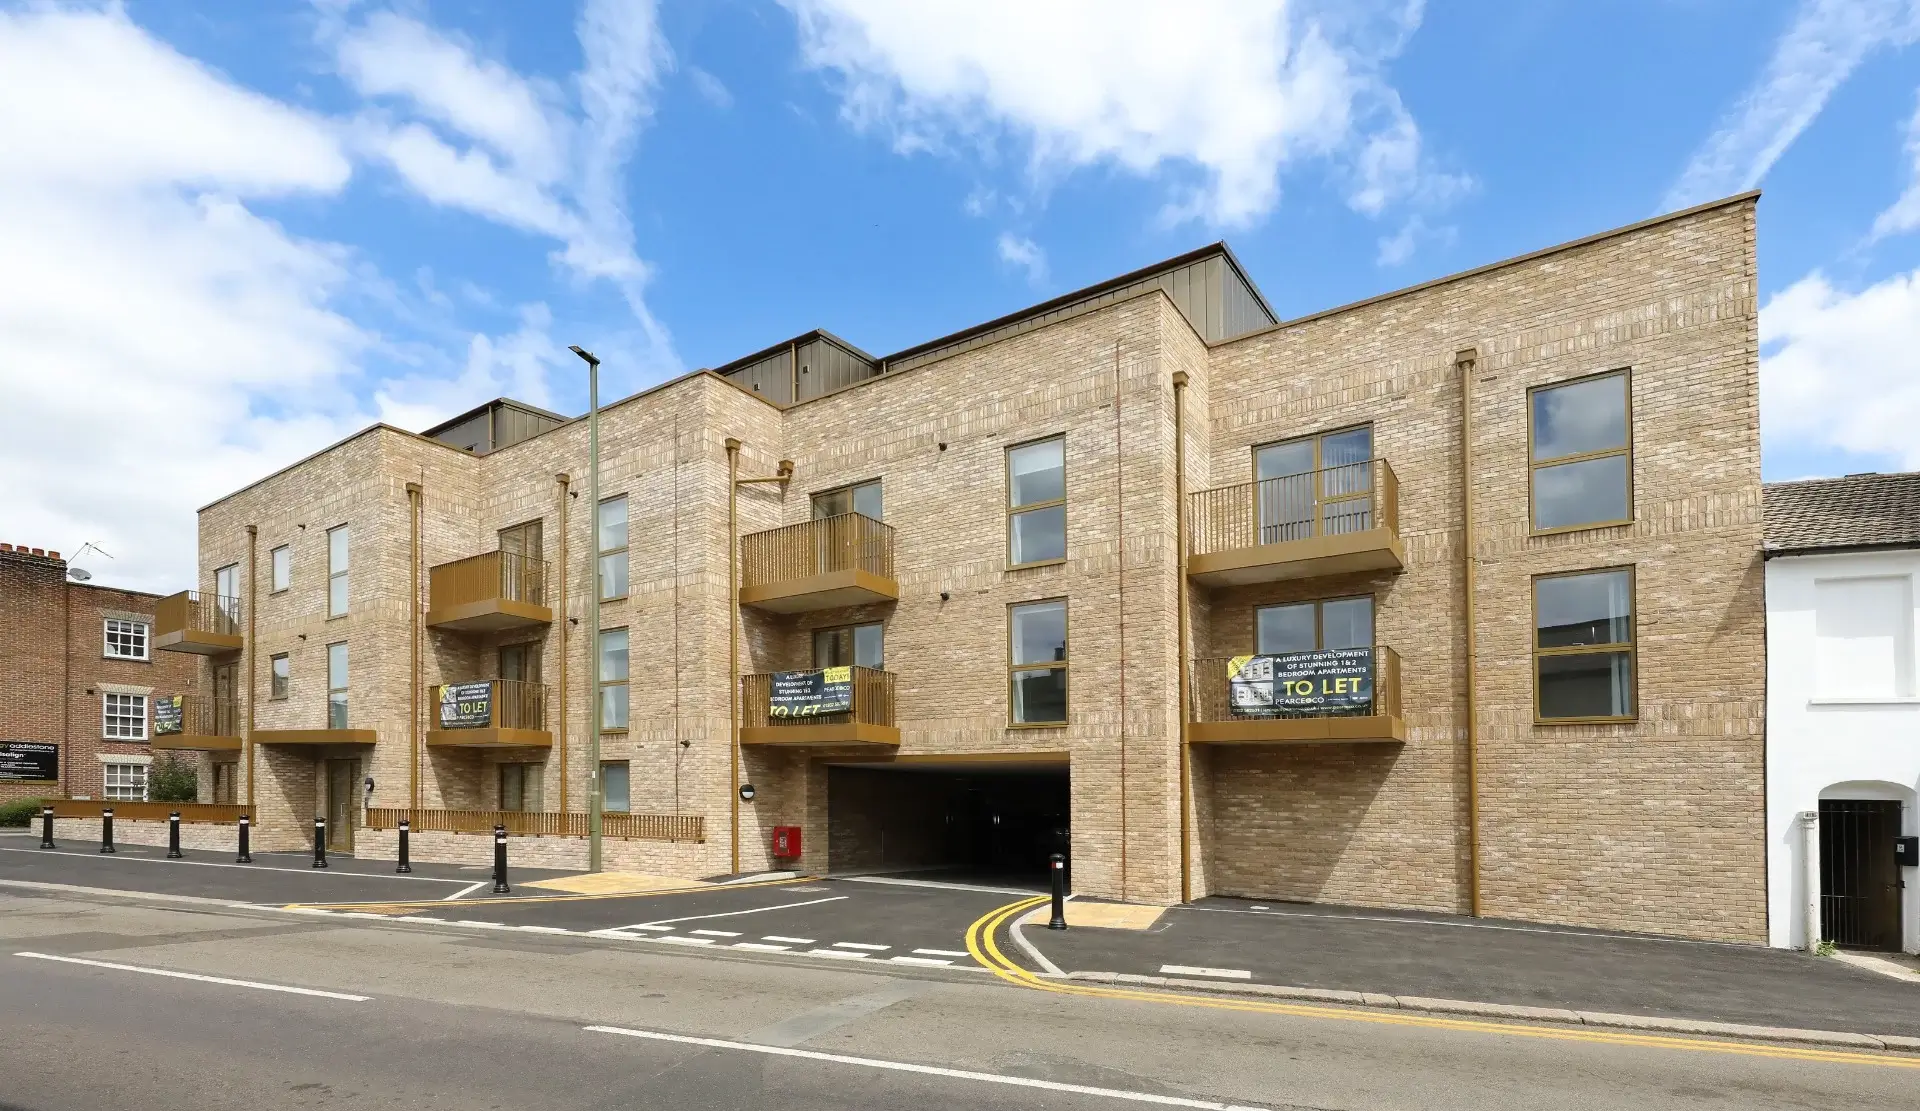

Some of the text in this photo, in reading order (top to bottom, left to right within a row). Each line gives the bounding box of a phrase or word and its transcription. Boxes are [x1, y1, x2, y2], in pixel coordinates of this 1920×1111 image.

[1282, 654, 1312, 662] LUXURY
[1313, 650, 1369, 660] DEVELOPMENT
[1299, 660, 1339, 669] STUNNING
[1278, 666, 1367, 678] BEDROOM APARTMENTS
[1283, 677, 1362, 696] TO LET
[459, 701, 488, 714] TO LET
[770, 705, 788, 719] TO
[792, 704, 822, 718] LET
